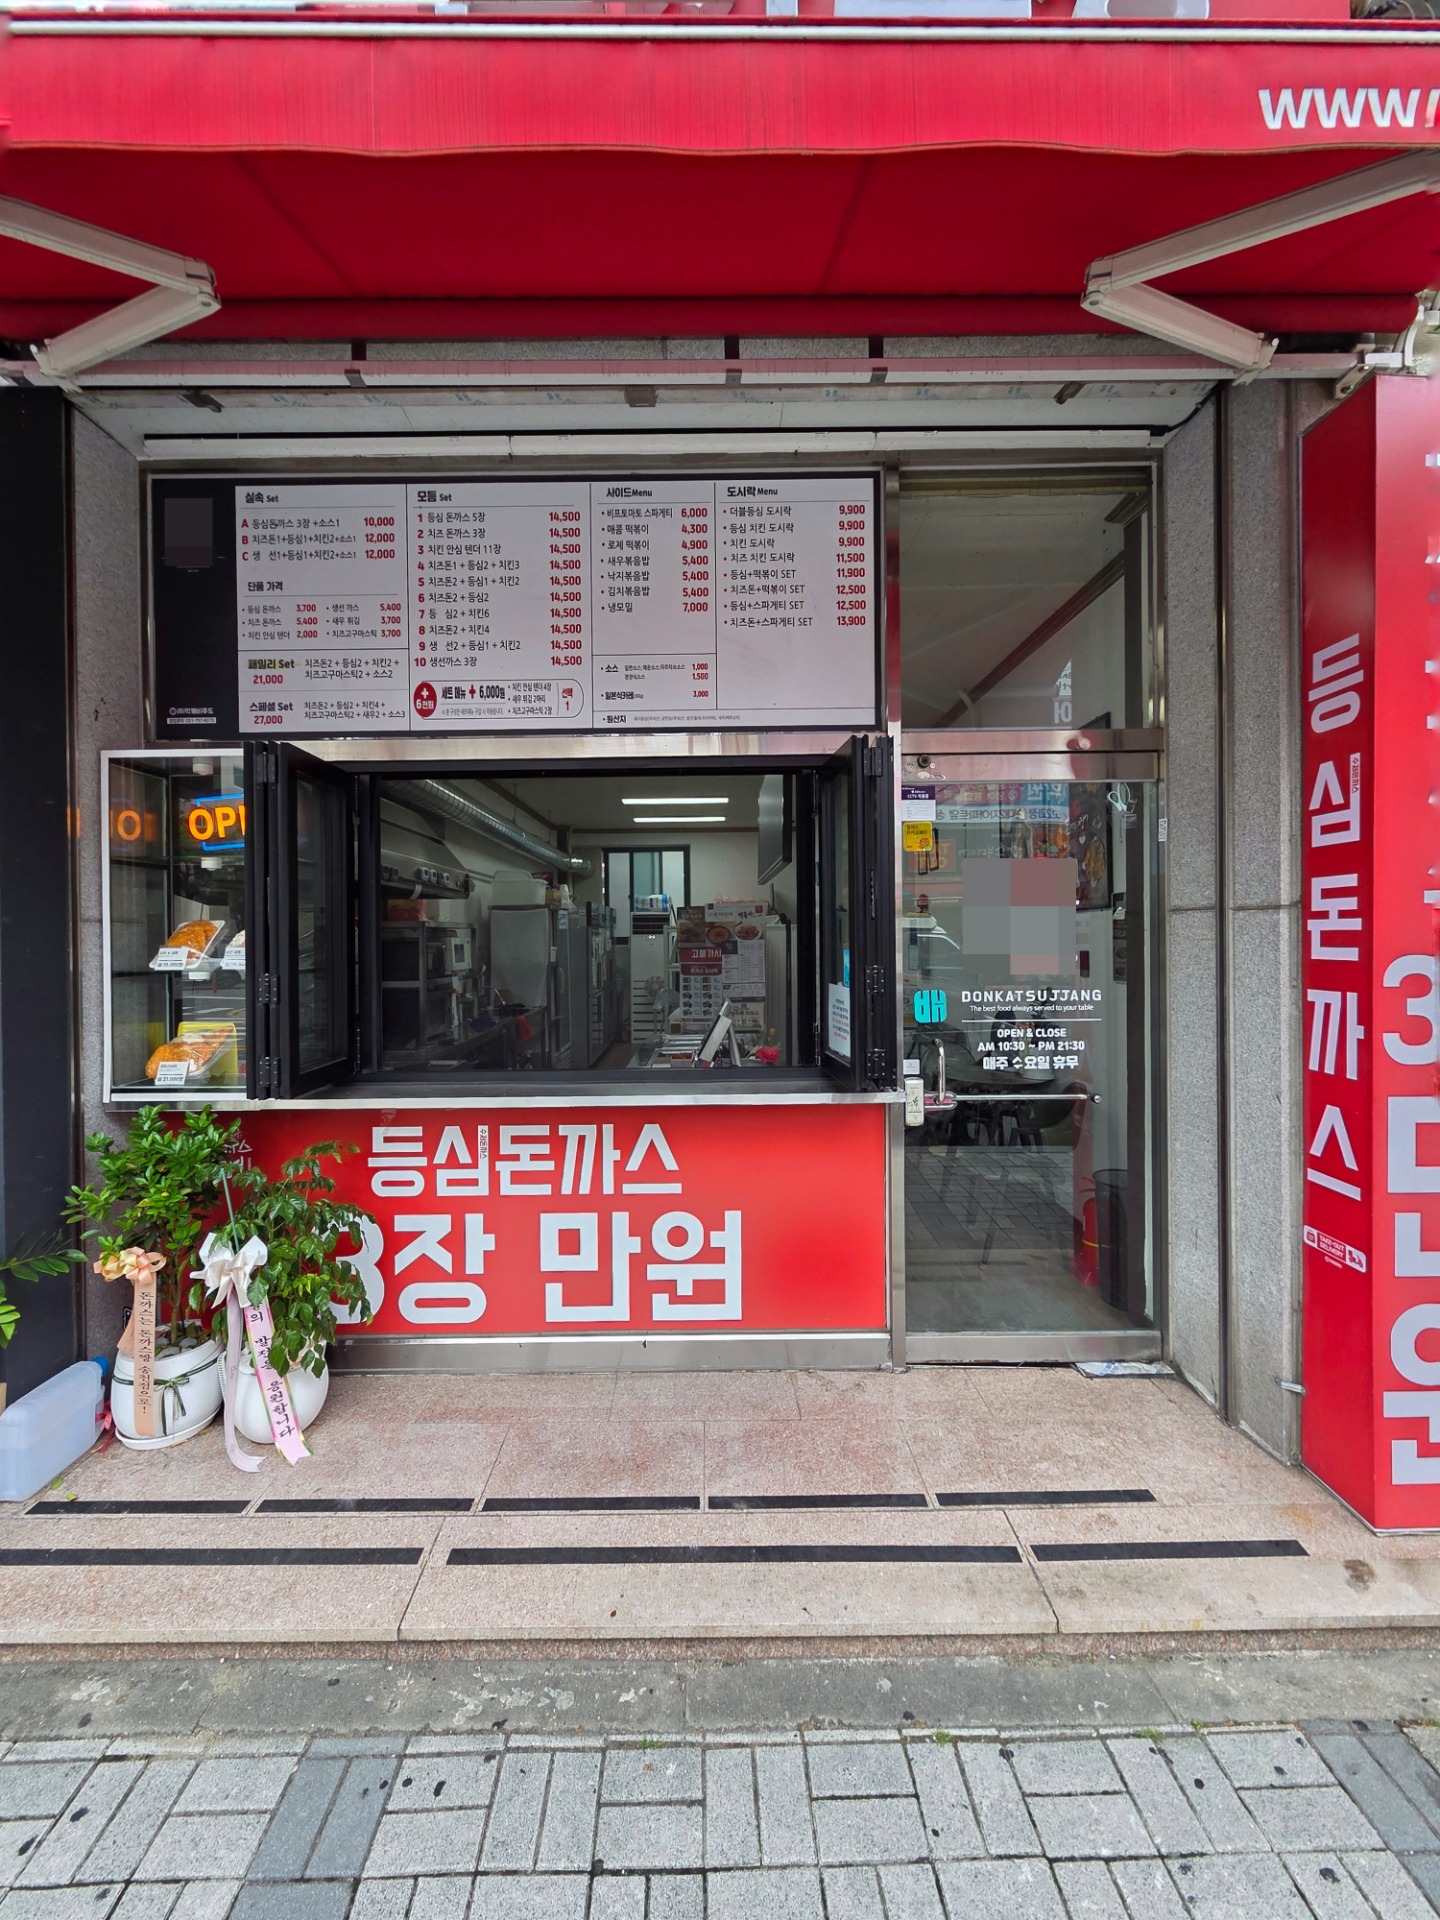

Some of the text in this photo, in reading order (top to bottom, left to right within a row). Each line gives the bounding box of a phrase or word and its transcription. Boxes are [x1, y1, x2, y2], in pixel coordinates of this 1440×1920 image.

[245, 492, 264, 503] 실속
[418, 491, 452, 502] 모듬 Set
[644, 508, 673, 518] 스파게티
[681, 508, 707, 518] 6,000
[730, 505, 865, 516] 더블등심 도시락 9,900
[364, 517, 394, 526] 10,000
[427, 512, 580, 522] 등심 돈까스 5장 14,500
[607, 524, 707, 535] 매콤 떡볶이 4,300
[730, 520, 865, 533] 등심 치킨 도시락 9,900
[365, 533, 395, 543] 12,000
[428, 528, 580, 538] 치즈 돈까스 3장 14,500
[608, 540, 708, 550] 로제 떡볶이 4,900
[730, 537, 865, 548] 치킨 도시락 9,900
[365, 550, 395, 559] 12,000
[428, 544, 581, 555] 치킨 안심 텐더 11장 14,500
[683, 556, 708, 566] 5,400
[731, 553, 865, 563] 치즈 치킨 도시락 11,500
[550, 560, 581, 570] 14,500
[683, 571, 709, 581] 5,400
[781, 570, 796, 578] SET
[837, 568, 865, 578] 11,900
[248, 581, 283, 591] 단품 가격
[550, 576, 581, 586] 14,500
[683, 588, 709, 598] 5,400
[790, 585, 805, 593] SET
[837, 585, 865, 595] 12,500
[550, 592, 581, 602] 14,500
[296, 604, 316, 613] 3,700
[380, 603, 401, 612] 5,400
[683, 603, 708, 612] 7,000
[790, 601, 804, 609] SET
[837, 601, 866, 610] 12,500
[550, 608, 581, 618] 14,500
[296, 617, 318, 625] 5,400
[381, 616, 401, 625] 3,700
[798, 618, 813, 626] SET
[837, 616, 865, 626] 13,900
[381, 629, 401, 638] 3,700
[550, 624, 582, 634] 14,500
[296, 630, 318, 639] 2,000
[550, 640, 582, 650] 14,500
[248, 659, 295, 669] 패밀리 Set
[430, 656, 582, 667] 생선까스 3장 14,500
[606, 664, 618, 672] 소스
[692, 663, 708, 671] 1,000
[253, 675, 283, 685] 21,000
[480, 685, 505, 700] 6,000원
[250, 702, 293, 711] 스페셜 Set
[254, 716, 283, 724] 27,000
[962, 990, 1101, 1002] DONKATSUJJANG
[997, 1028, 1067, 1037] OPEN & CLOSE
[978, 1041, 1085, 1051] AM 10:30 PM 21:30
[983, 1055, 1078, 1070] 매주 수요일 휴무
[368, 1123, 682, 1197] 등심돈까스
[540, 1210, 742, 1322] 만원
